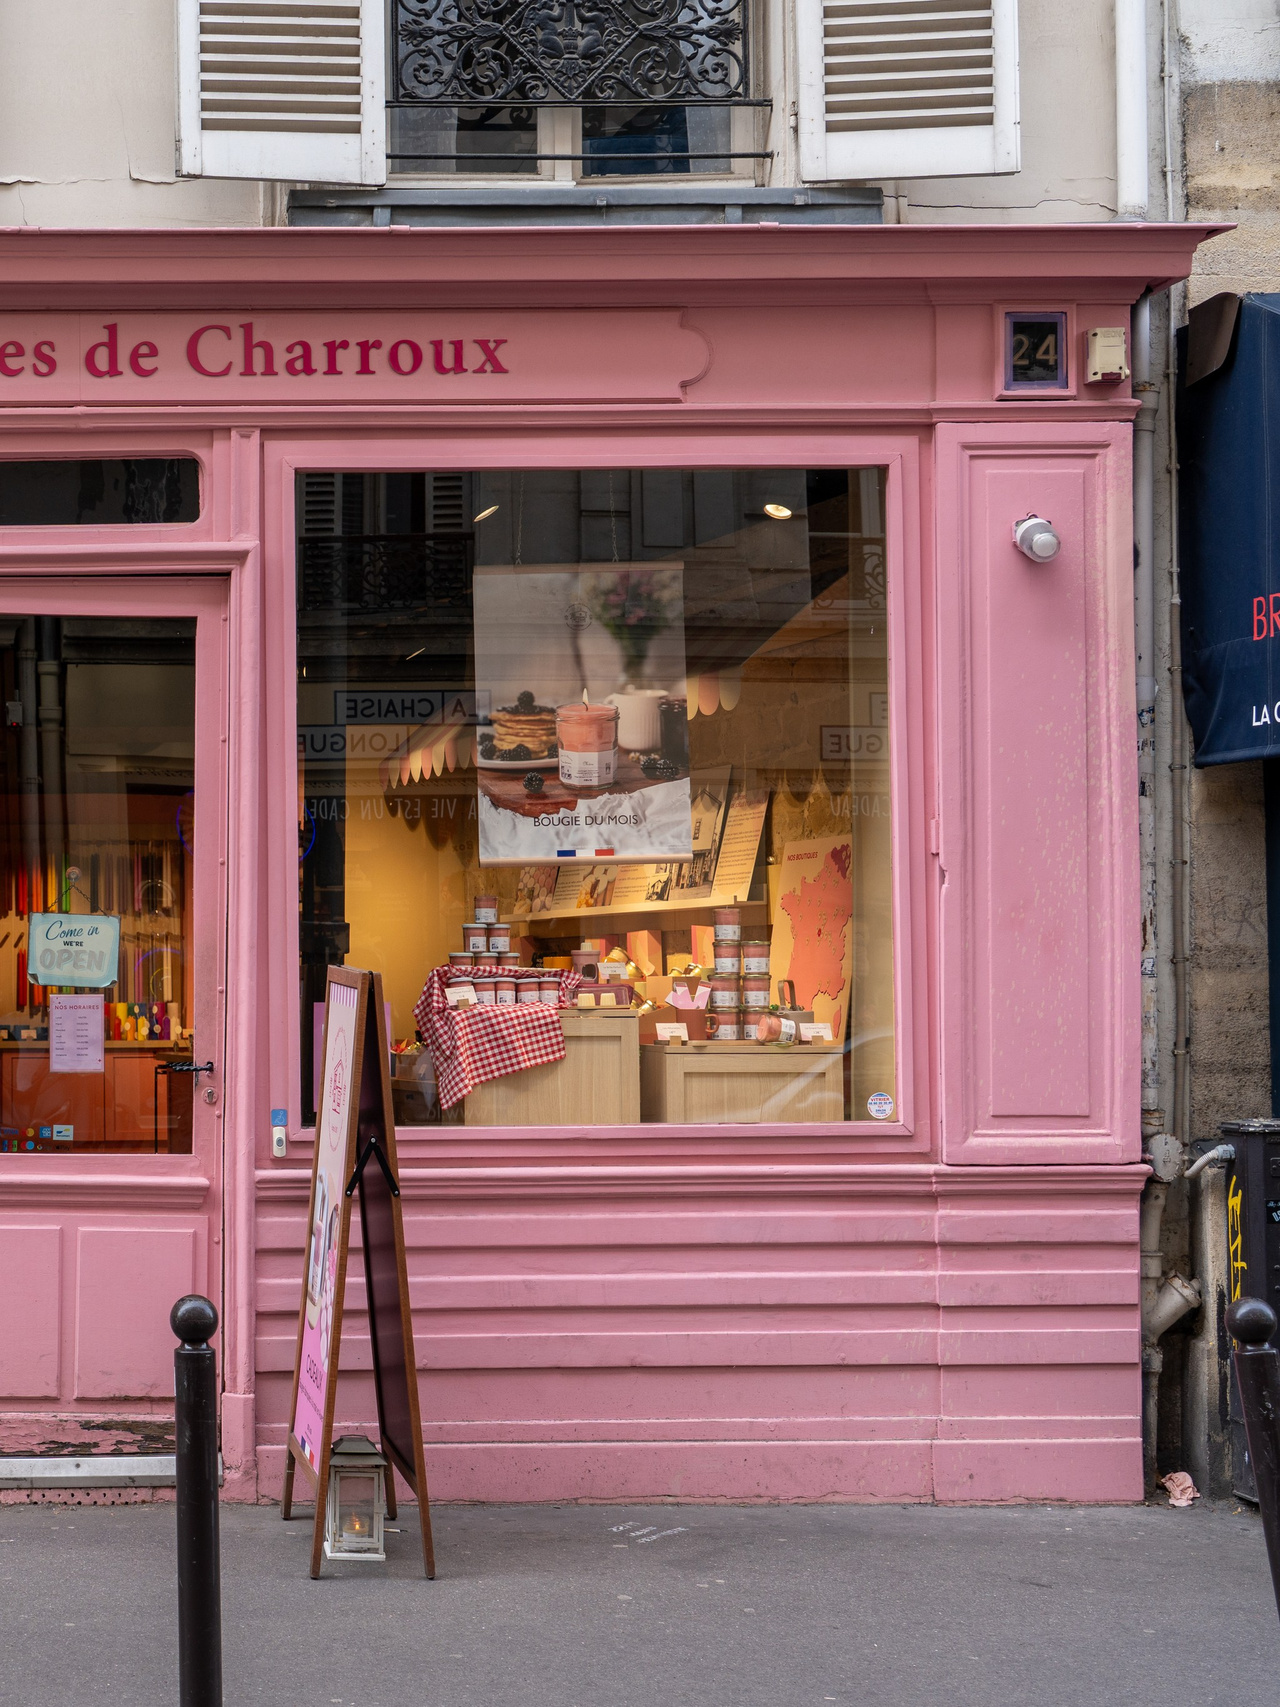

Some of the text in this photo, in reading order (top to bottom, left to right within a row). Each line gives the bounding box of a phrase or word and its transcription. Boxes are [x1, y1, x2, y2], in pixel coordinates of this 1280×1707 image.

[84, 322, 159, 378] de
[185, 321, 510, 377] Charroux
[1013, 333, 1058, 366] 24
[1252, 704, 1271, 726] LA
[533, 814, 639, 827] BOUGIE DU MOIS
[796, 851, 819, 861] BOUTIQUES
[46, 920, 100, 941] Come in
[39, 948, 106, 972] OPEN
